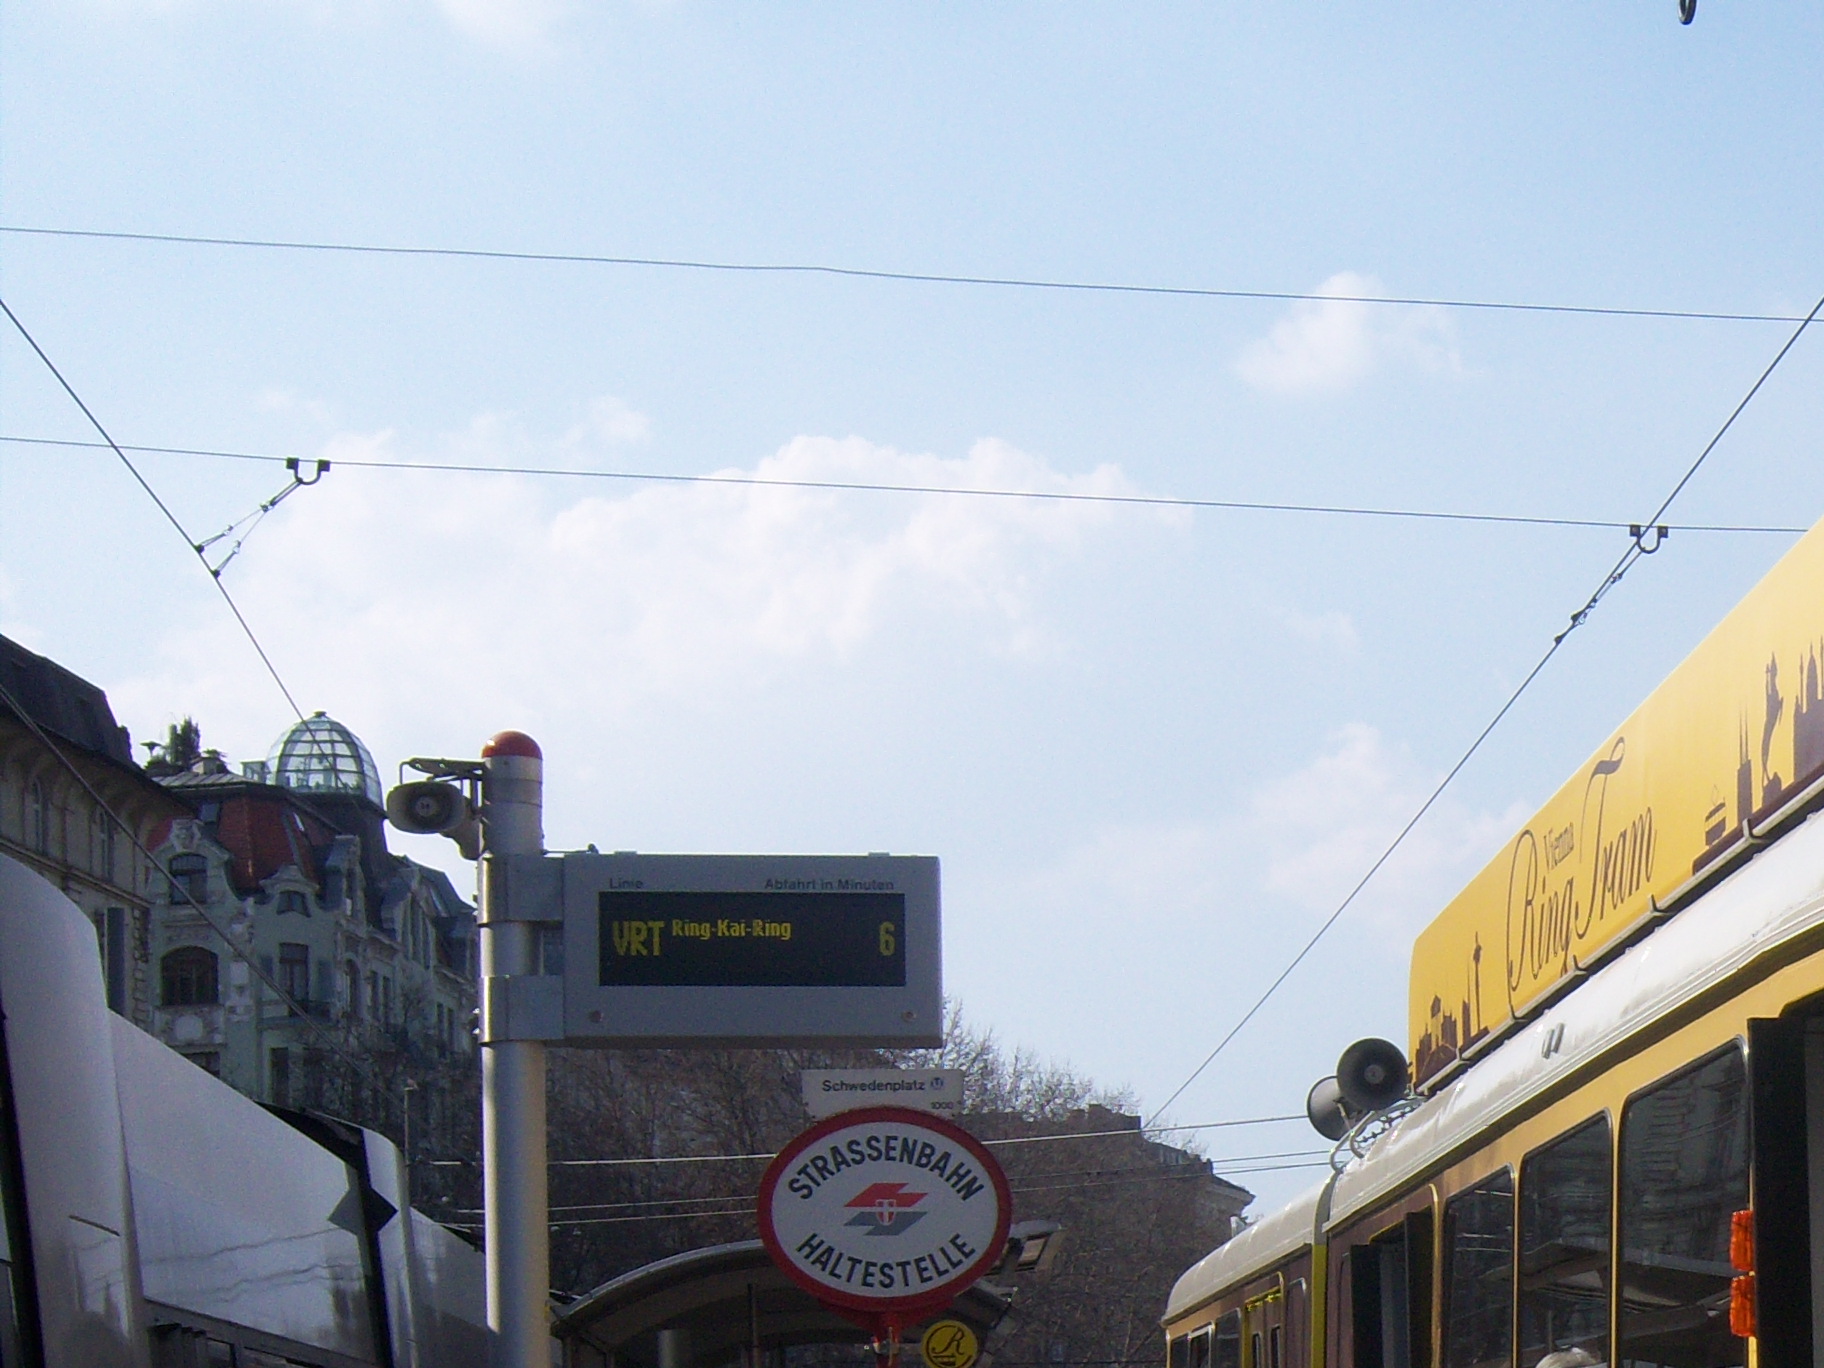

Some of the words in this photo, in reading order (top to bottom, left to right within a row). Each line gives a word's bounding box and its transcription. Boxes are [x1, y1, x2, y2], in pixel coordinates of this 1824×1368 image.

[1506, 828, 1574, 992] Ring
[1575, 736, 1658, 940] Tram
[1543, 820, 1575, 876] Vienna
[609, 877, 644, 890] Linie
[764, 878, 816, 890] Abfahrt
[821, 878, 834, 890] in
[837, 878, 895, 891] Minuten
[612, 920, 665, 957] VRT
[671, 918, 792, 941] Ring-Kai-Ring
[878, 920, 896, 957] 6
[822, 1079, 926, 1093] Schwedenplatz
[788, 1135, 985, 1201] STRASSENBAHN
[796, 1232, 977, 1290] HALTESTELLE
